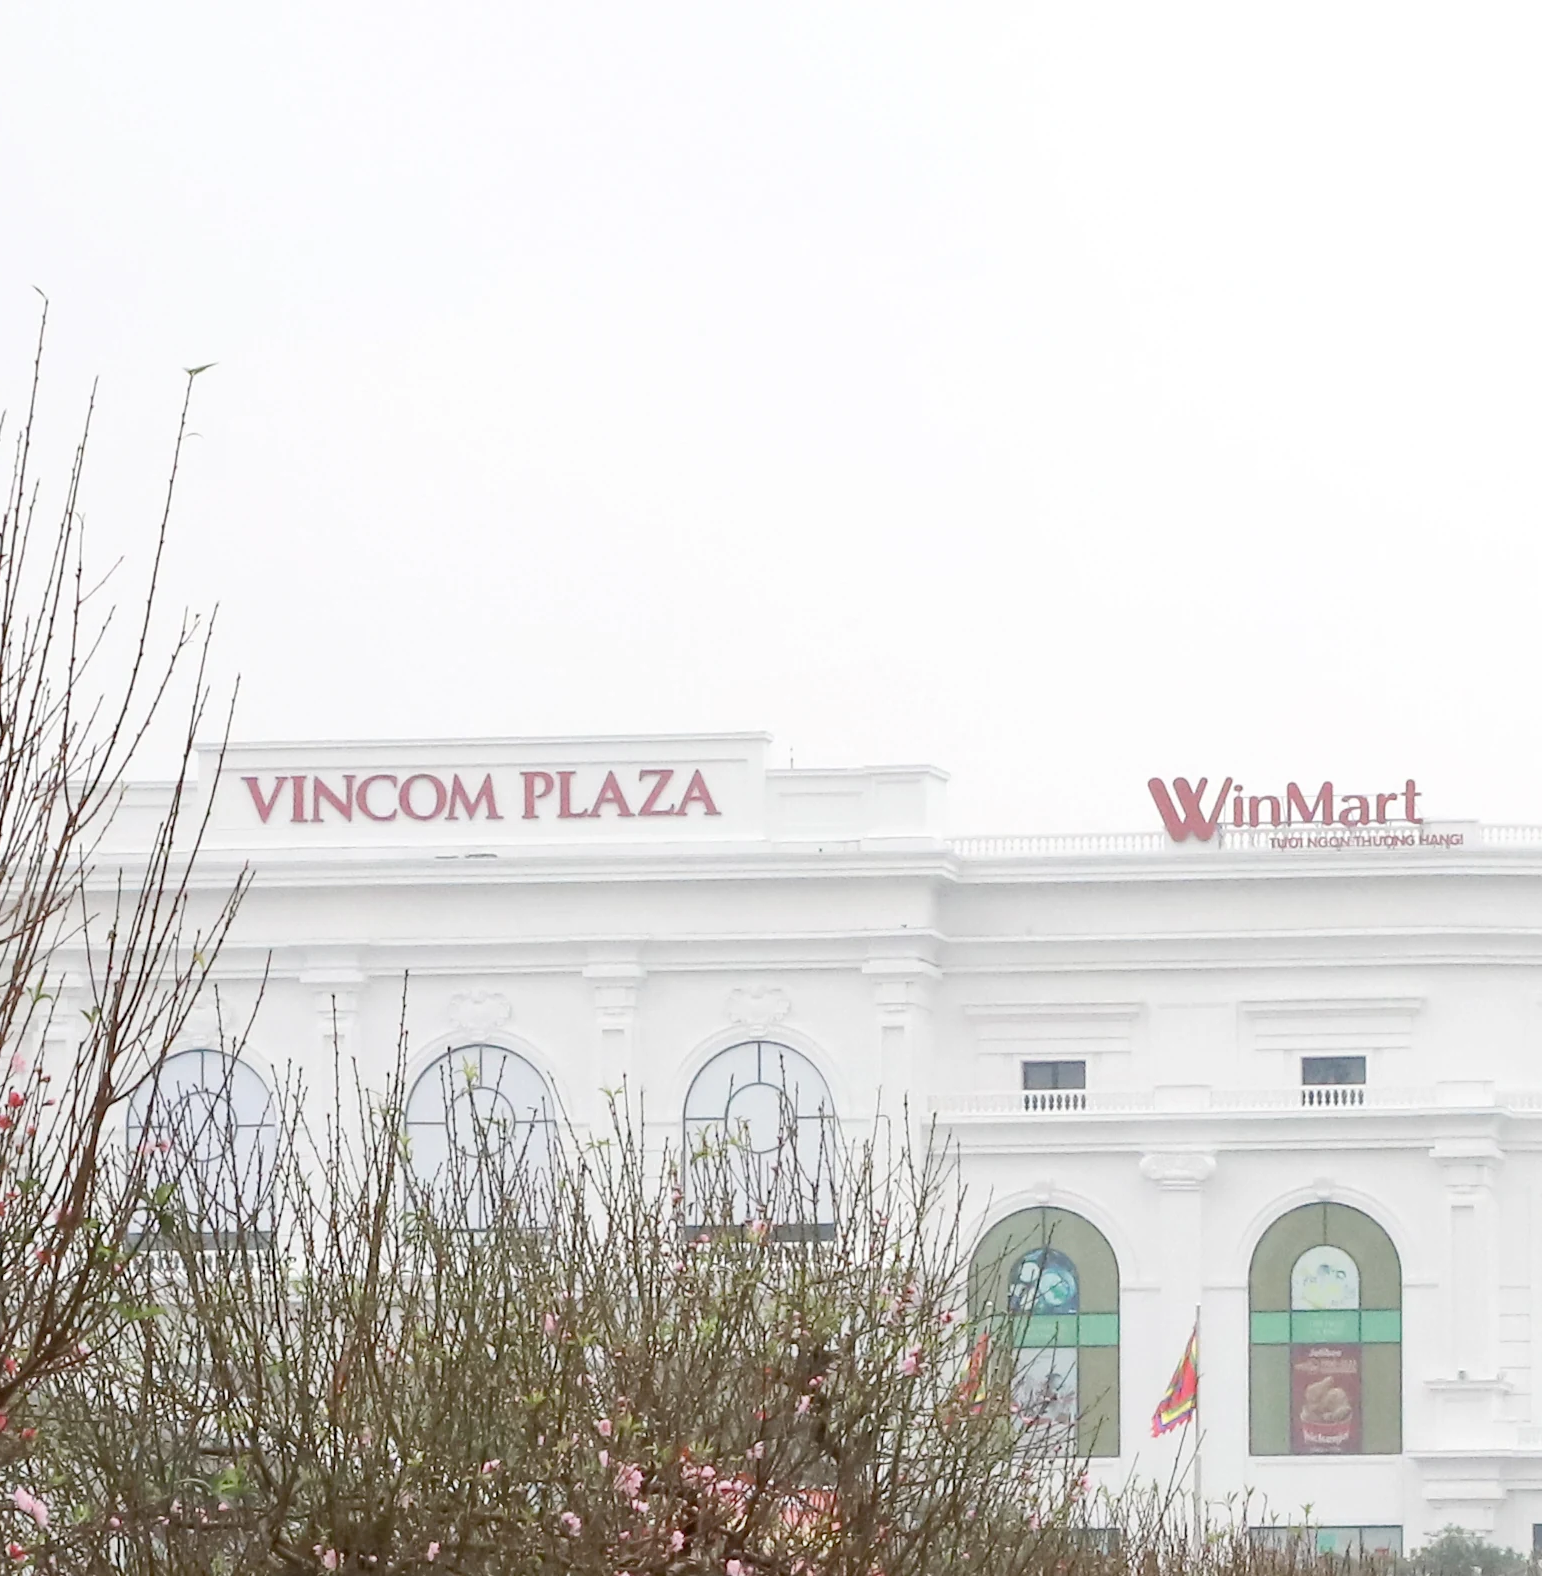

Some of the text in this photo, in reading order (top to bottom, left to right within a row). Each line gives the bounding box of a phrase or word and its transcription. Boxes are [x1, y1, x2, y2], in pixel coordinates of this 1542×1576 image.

[241, 769, 722, 824] VINCOM PLAZA
[1148, 777, 1424, 842] WinMart
